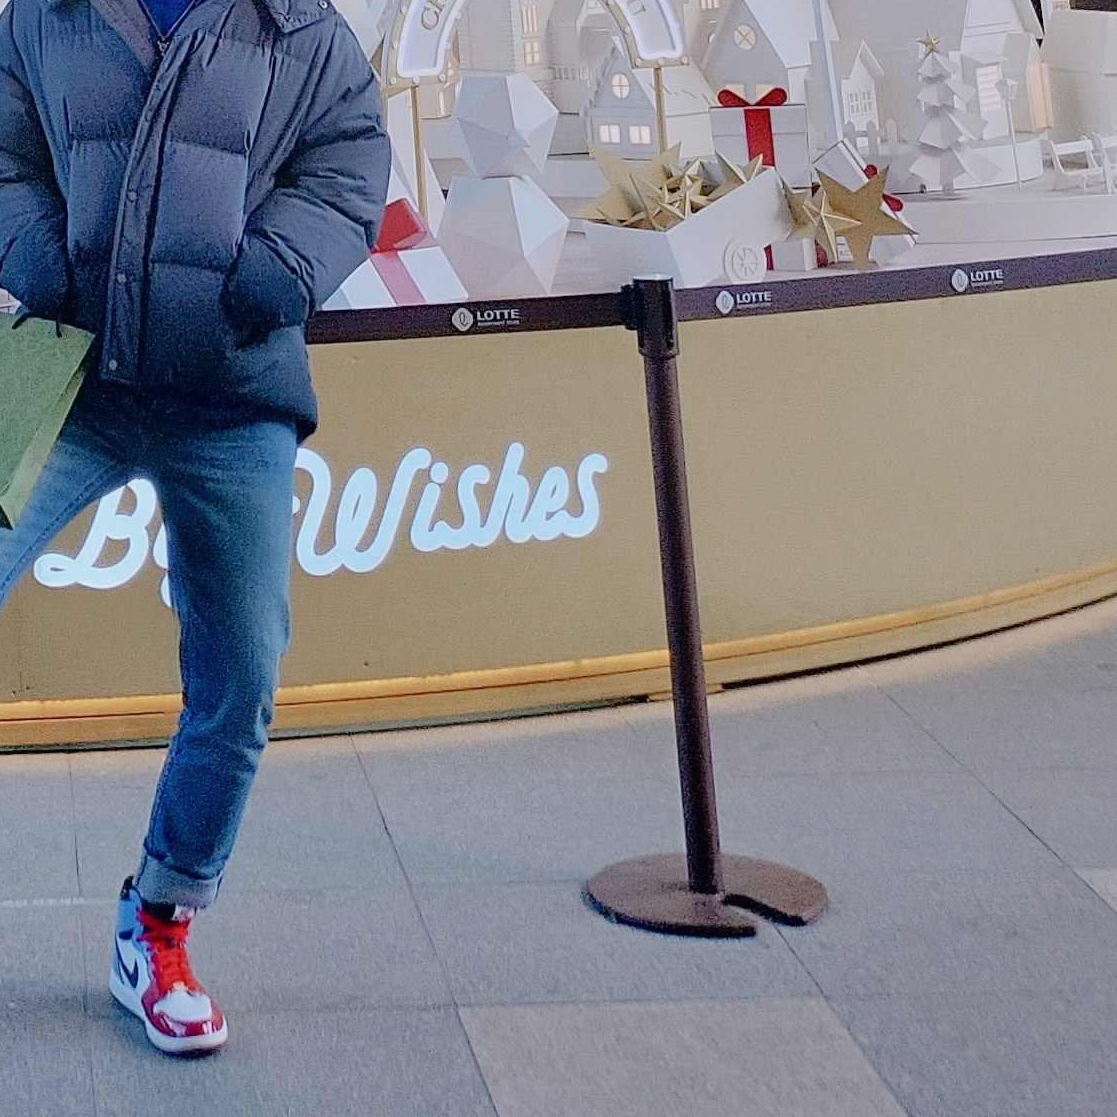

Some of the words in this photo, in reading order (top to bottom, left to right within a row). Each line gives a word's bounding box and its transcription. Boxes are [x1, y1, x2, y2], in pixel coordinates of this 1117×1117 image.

[970, 269, 1004, 282] LOTTE
[736, 291, 772, 304] LOTTE
[476, 309, 520, 321] LOTTE
[292, 441, 609, 577] Wishes
